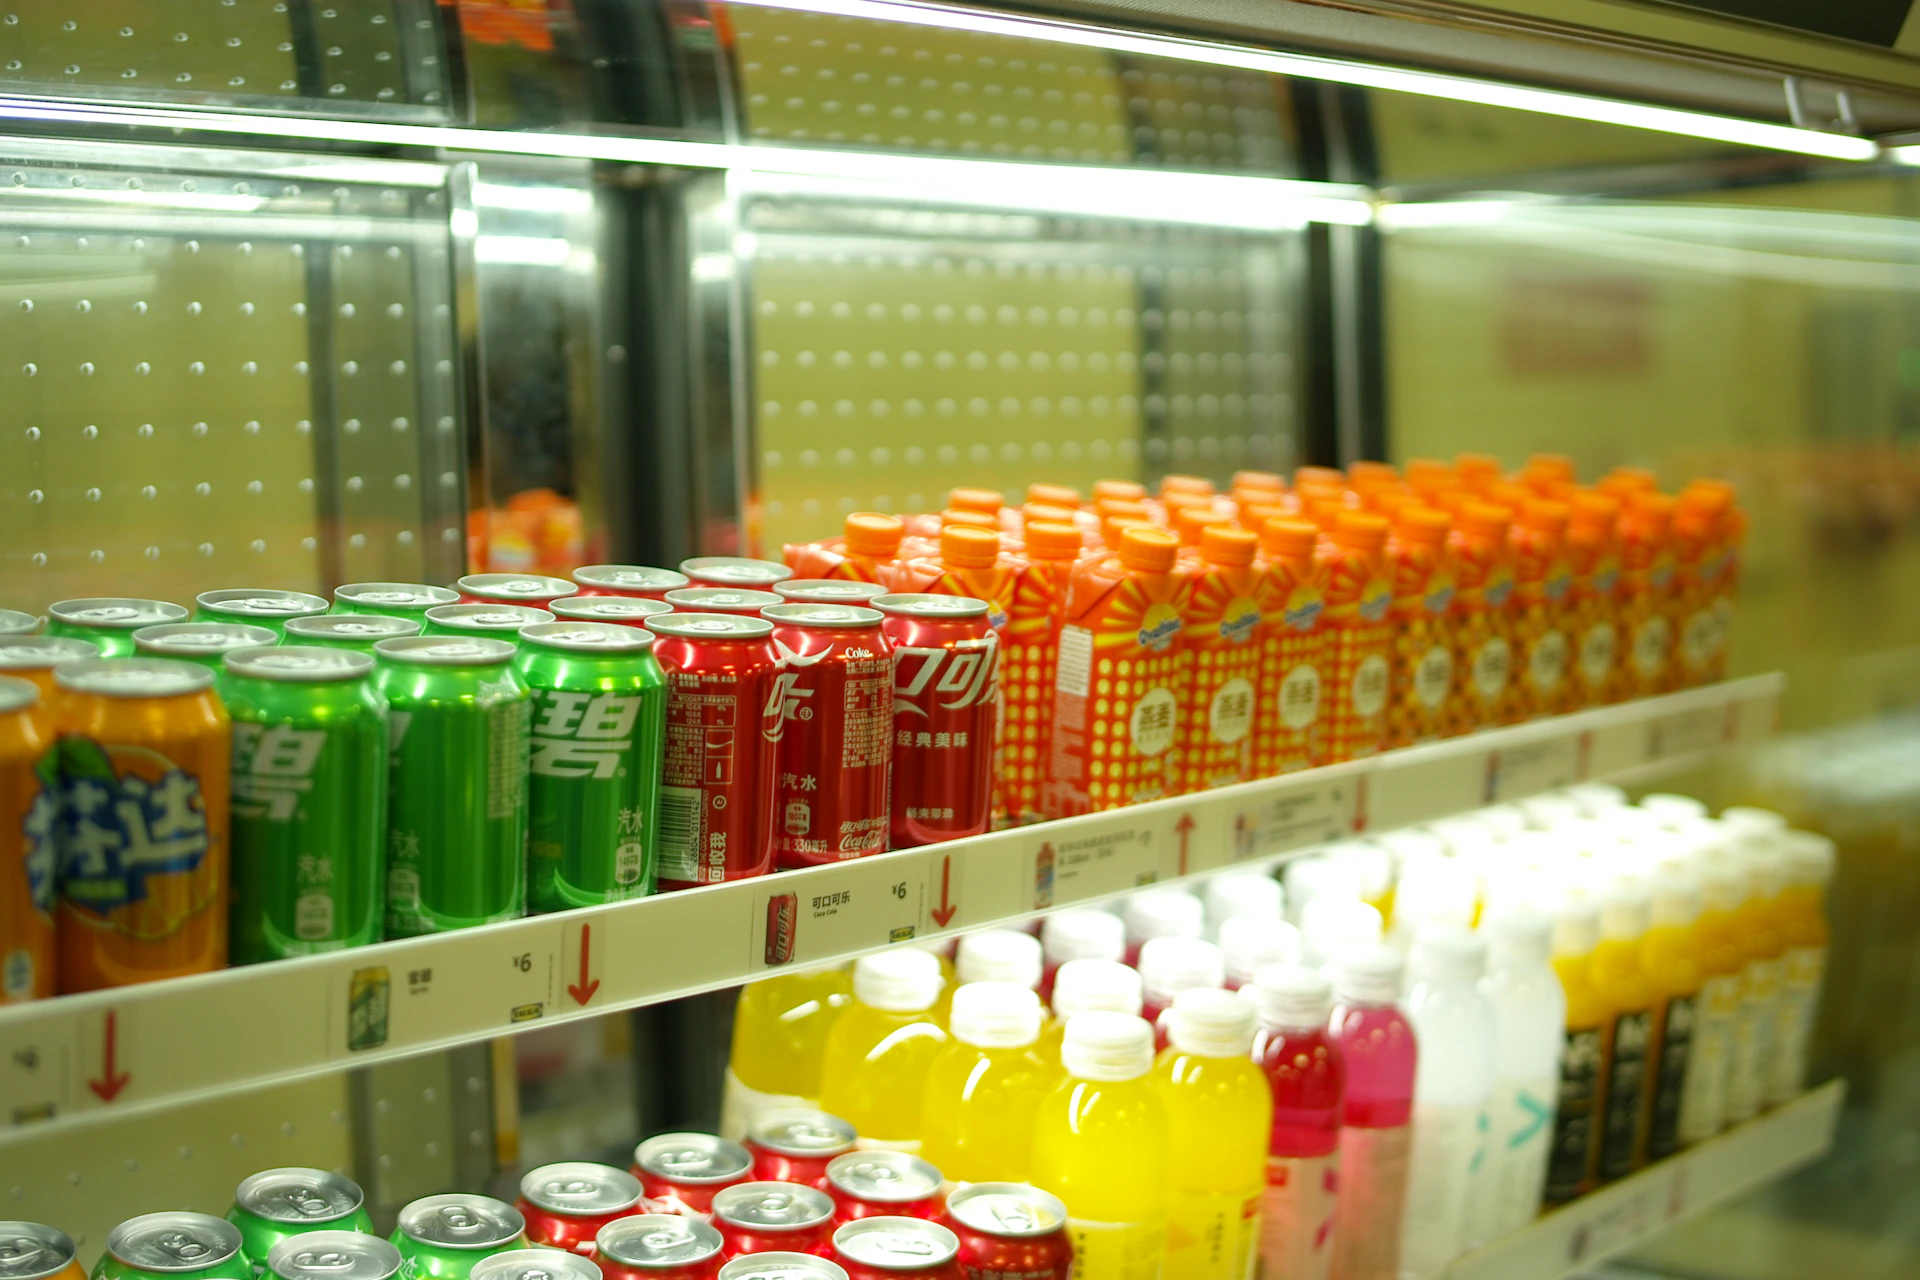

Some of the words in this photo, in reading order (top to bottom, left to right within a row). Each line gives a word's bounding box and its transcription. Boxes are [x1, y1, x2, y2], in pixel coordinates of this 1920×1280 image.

[845, 647, 874, 659] Coke
[894, 629, 999, 710] 口可
[530, 691, 642, 779] 碧
[897, 730, 968, 748] 经典美味
[781, 772, 817, 791] 汽水
[617, 805, 643, 835] 汽水
[691, 799, 700, 832] 011142
[708, 831, 727, 882] 回收我
[812, 890, 851, 909] 可口可乐
[892, 881, 907, 899] ¥6
[813, 910, 826, 918] Coca
[826, 908, 838, 916] Cola
[512, 952, 532, 973] ¥6
